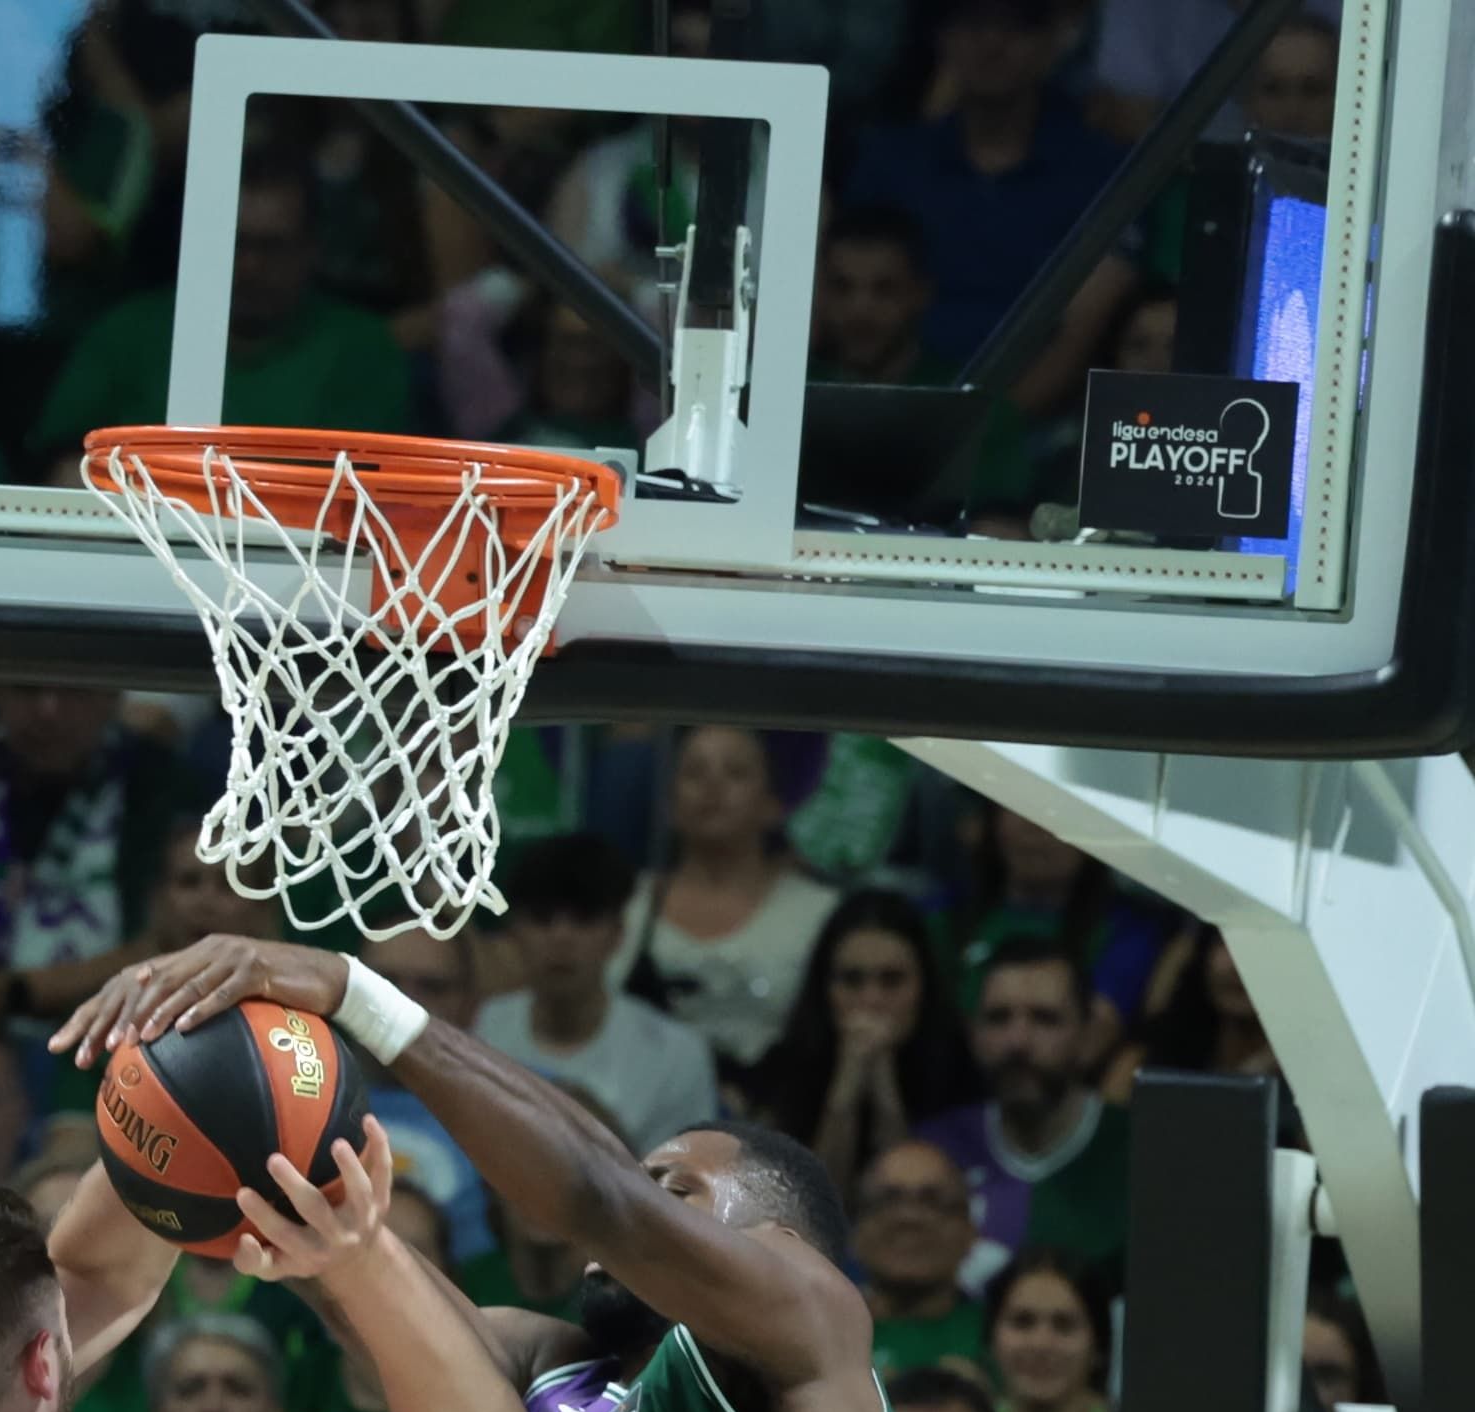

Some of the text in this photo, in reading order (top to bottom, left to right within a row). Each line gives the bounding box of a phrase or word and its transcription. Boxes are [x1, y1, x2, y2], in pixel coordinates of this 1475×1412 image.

[1147, 425, 1218, 443] endesa
[1109, 442, 1247, 475] PLAYOFF
[1174, 475, 1214, 486] 2024
